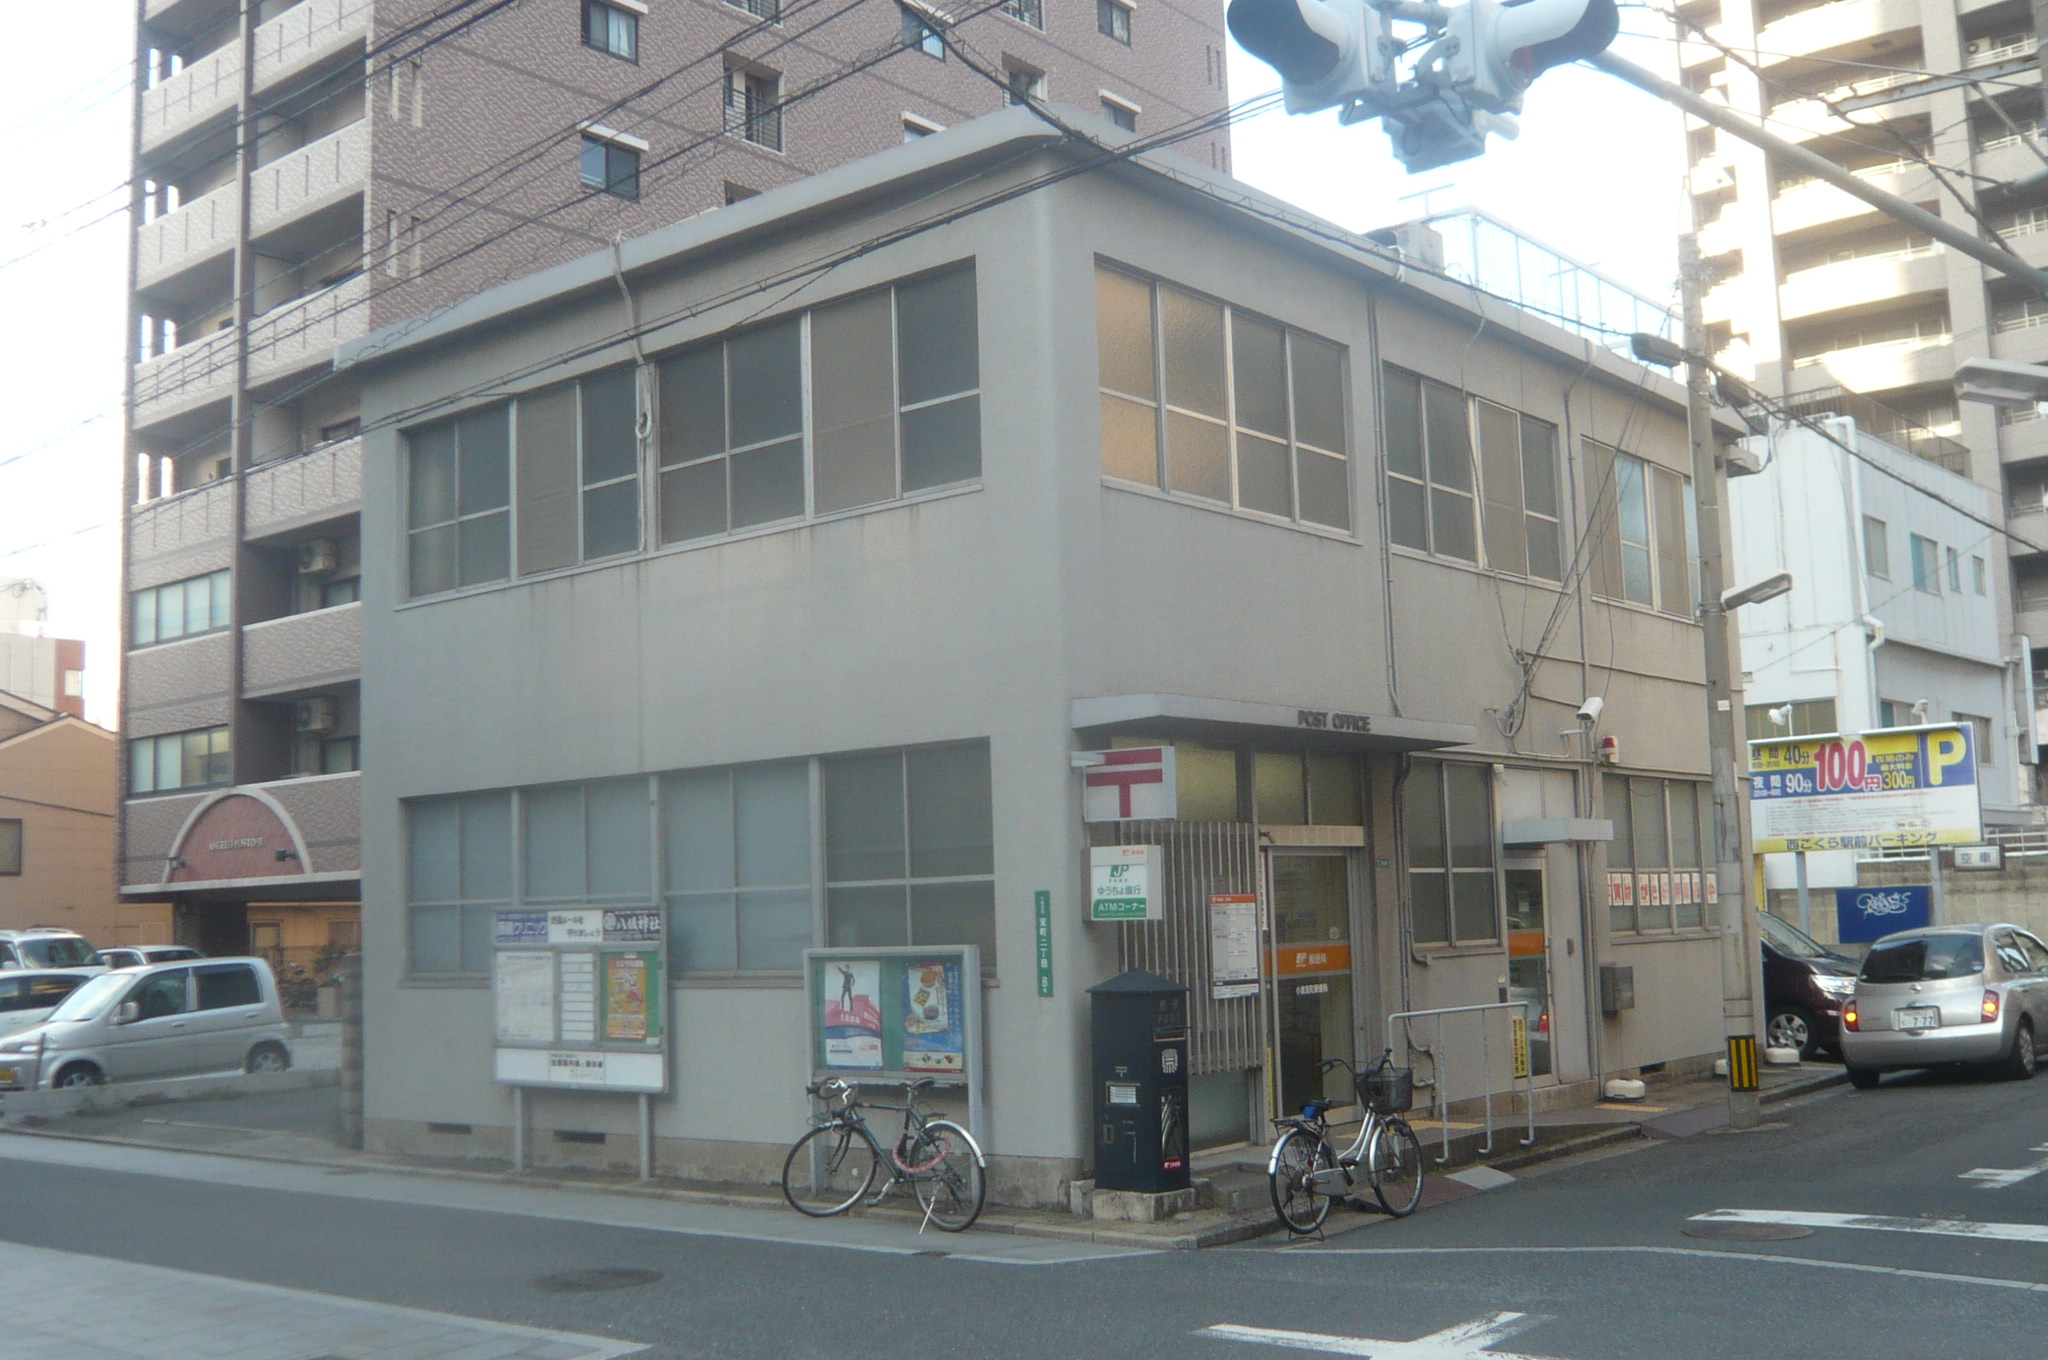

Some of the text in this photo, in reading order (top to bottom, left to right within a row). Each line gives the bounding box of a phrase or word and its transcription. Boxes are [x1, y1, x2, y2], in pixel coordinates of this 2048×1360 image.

[1298, 710, 1371, 732] POST OFFICE
[1784, 745, 1810, 764] 40分
[1928, 730, 1966, 786] P
[1814, 740, 1881, 791] 100円
[1753, 774, 1782, 789] 夜間
[1786, 773, 1813, 794] 90分
[1883, 771, 1915, 789] 300円
[1786, 831, 1937, 850] 西こくら駅前パーキング
[1960, 851, 1991, 864] 空車
[1110, 864, 1130, 877] JP
[1097, 885, 1141, 895] ゆうちょ銀行
[1098, 902, 1146, 912] ATMコーナー
[1039, 918, 1048, 968] 室町二丁目
